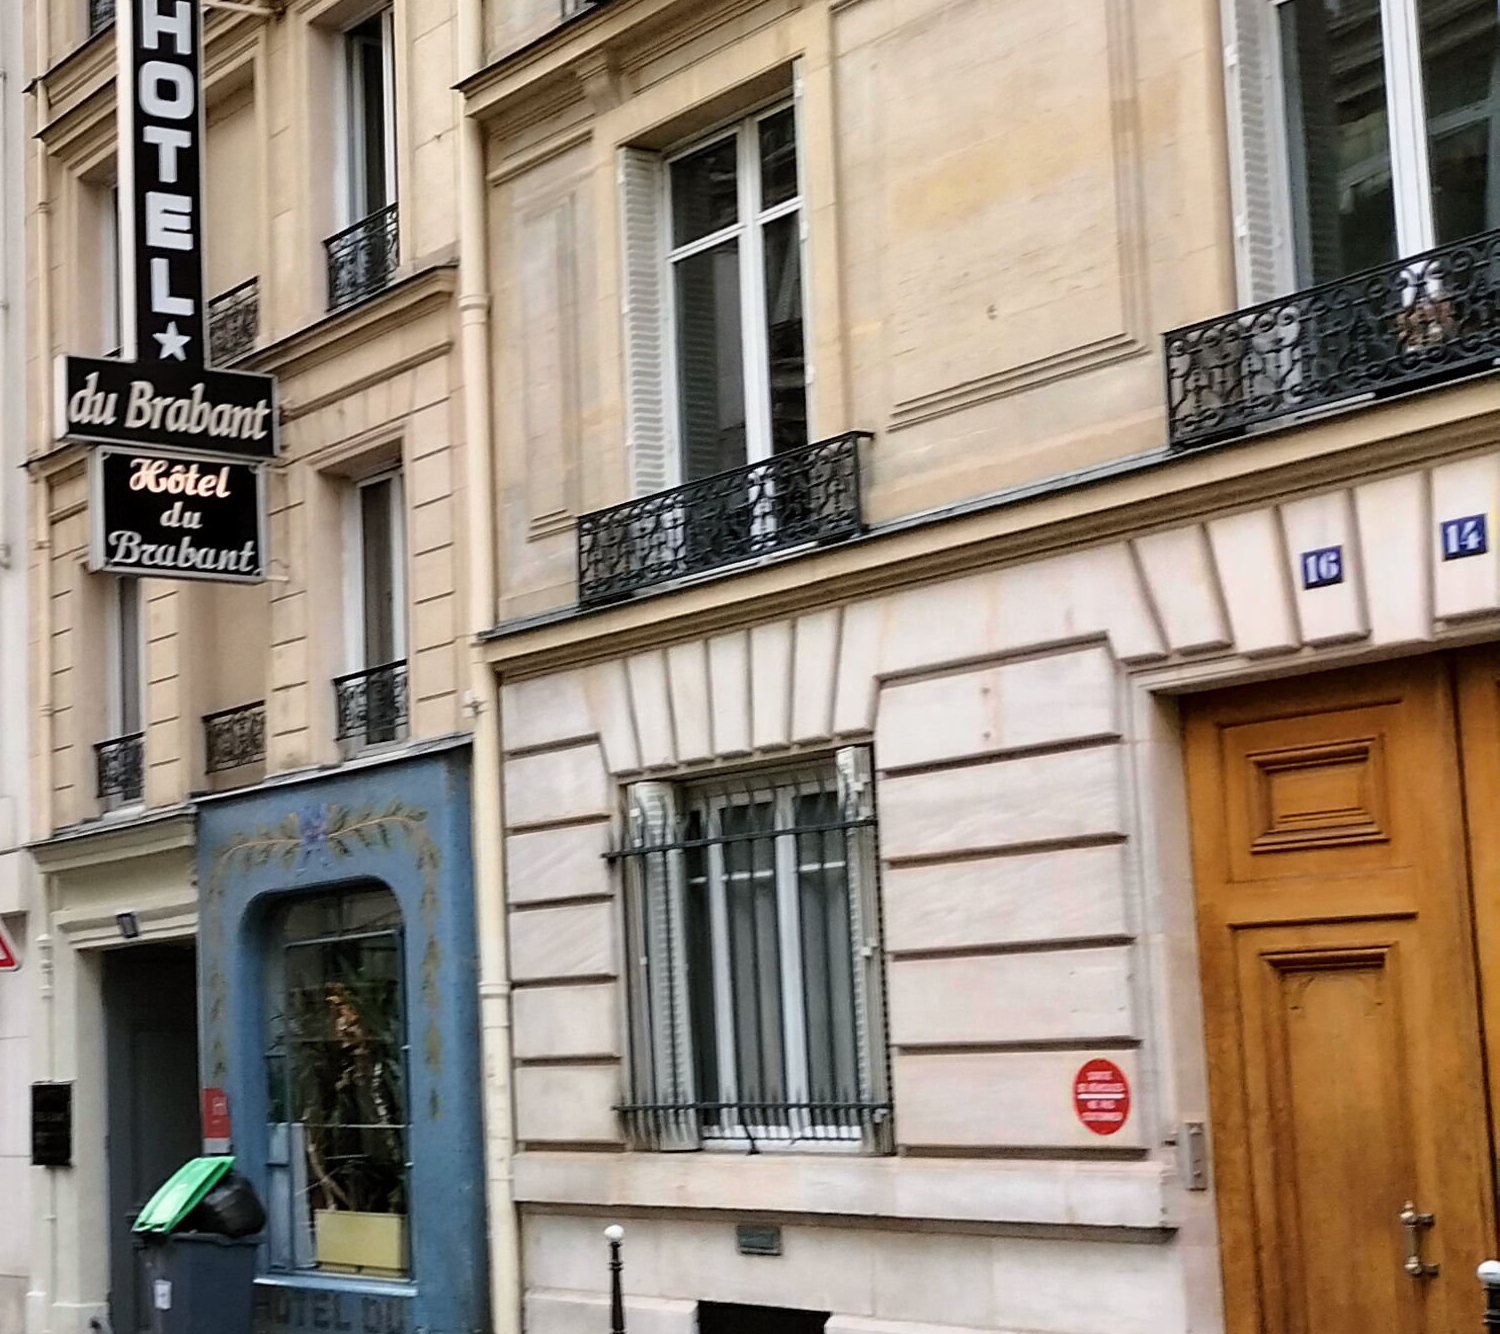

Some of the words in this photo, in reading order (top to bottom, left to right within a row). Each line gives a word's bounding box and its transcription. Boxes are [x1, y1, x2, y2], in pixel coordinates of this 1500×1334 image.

[69, 371, 119, 426] du
[124, 380, 272, 441] Brabant
[129, 457, 232, 499] Hôtel
[159, 501, 204, 530] du
[107, 529, 256, 573] Brabant
[1445, 520, 1483, 555] 14
[1304, 551, 1339, 584] 16
